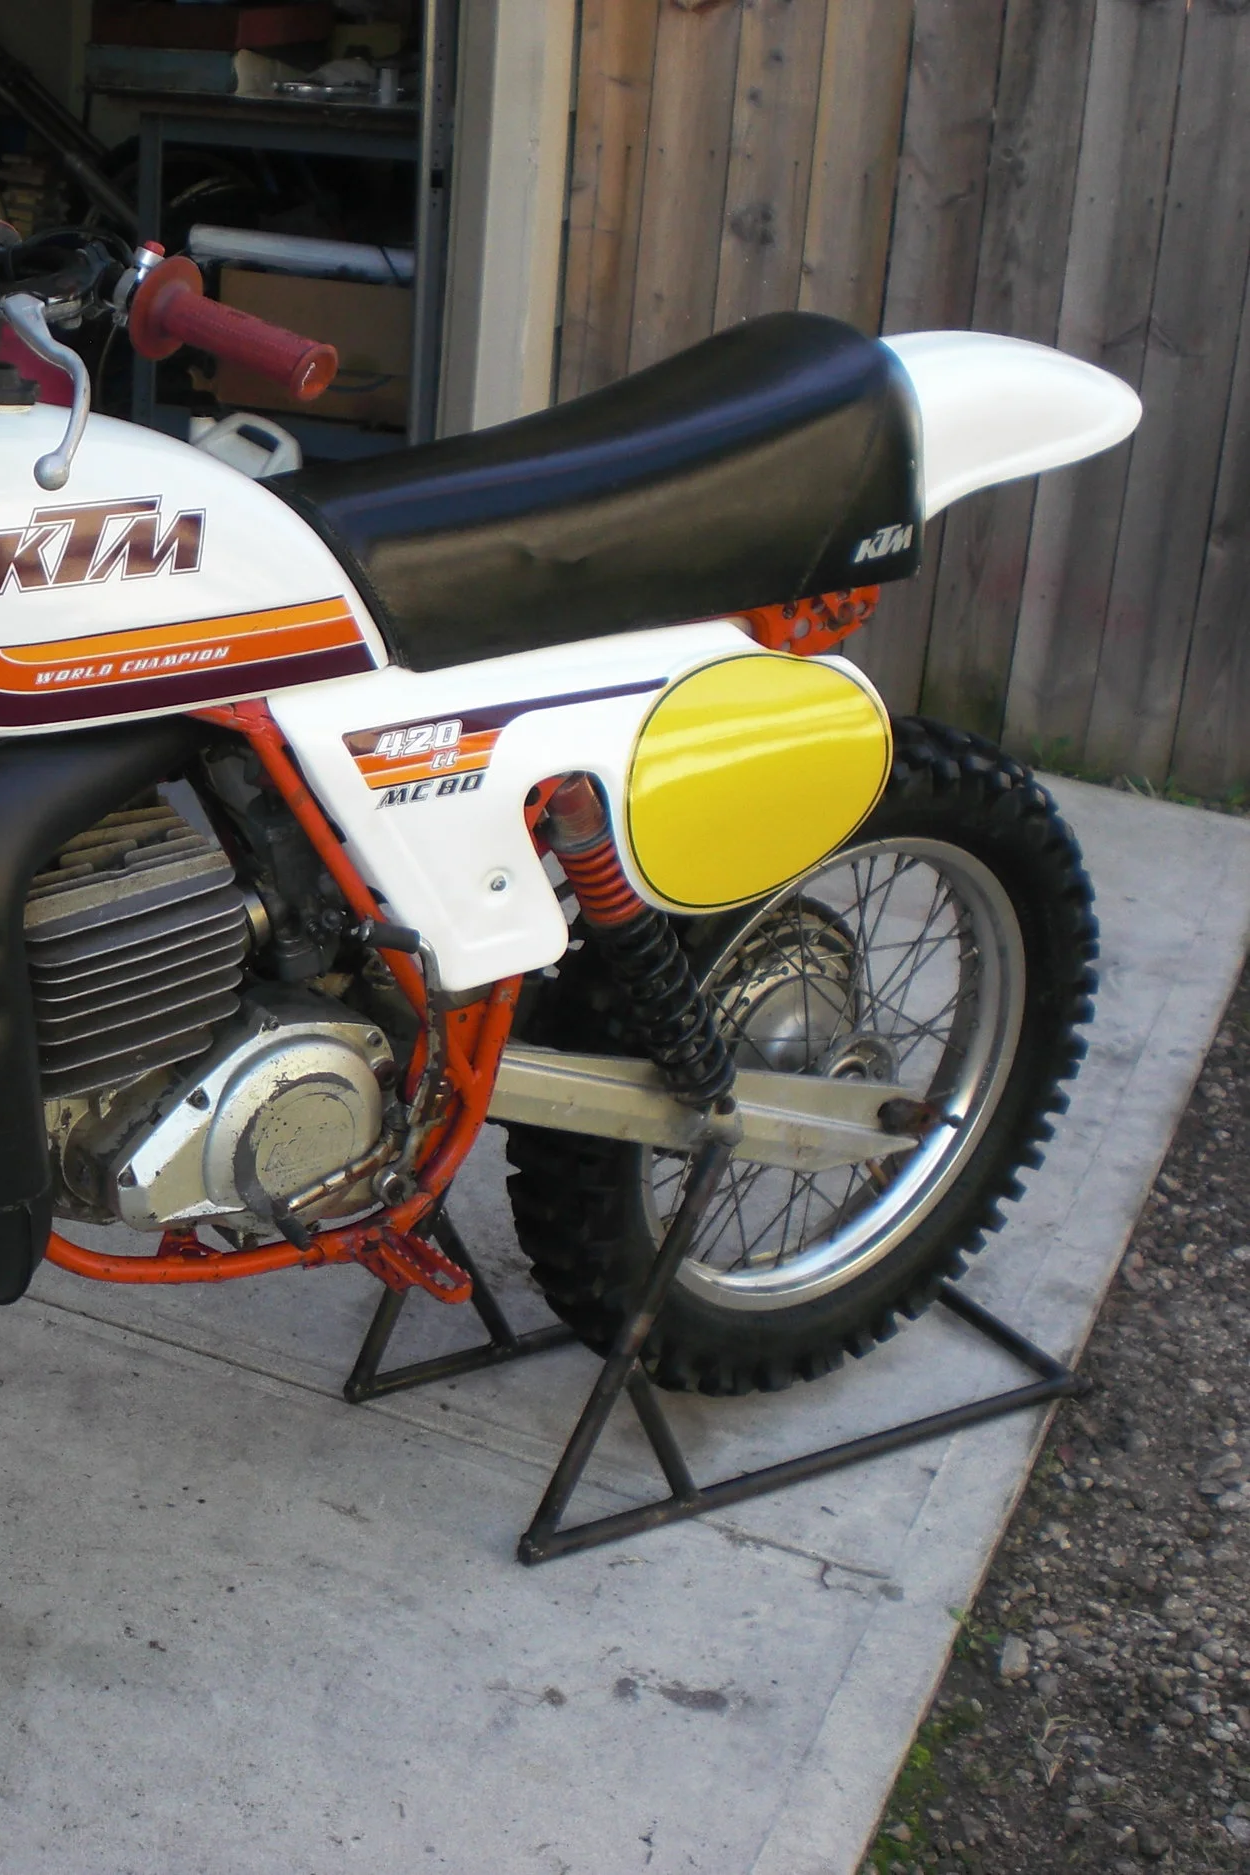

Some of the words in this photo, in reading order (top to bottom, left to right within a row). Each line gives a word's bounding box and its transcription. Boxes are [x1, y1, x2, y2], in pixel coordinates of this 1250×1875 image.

[854, 523, 913, 563] KTM
[34, 664, 114, 685] WORLD
[120, 645, 231, 674] CHAMPION
[373, 719, 463, 760] 420
[375, 780, 434, 810] MC
[436, 771, 486, 798] 80
